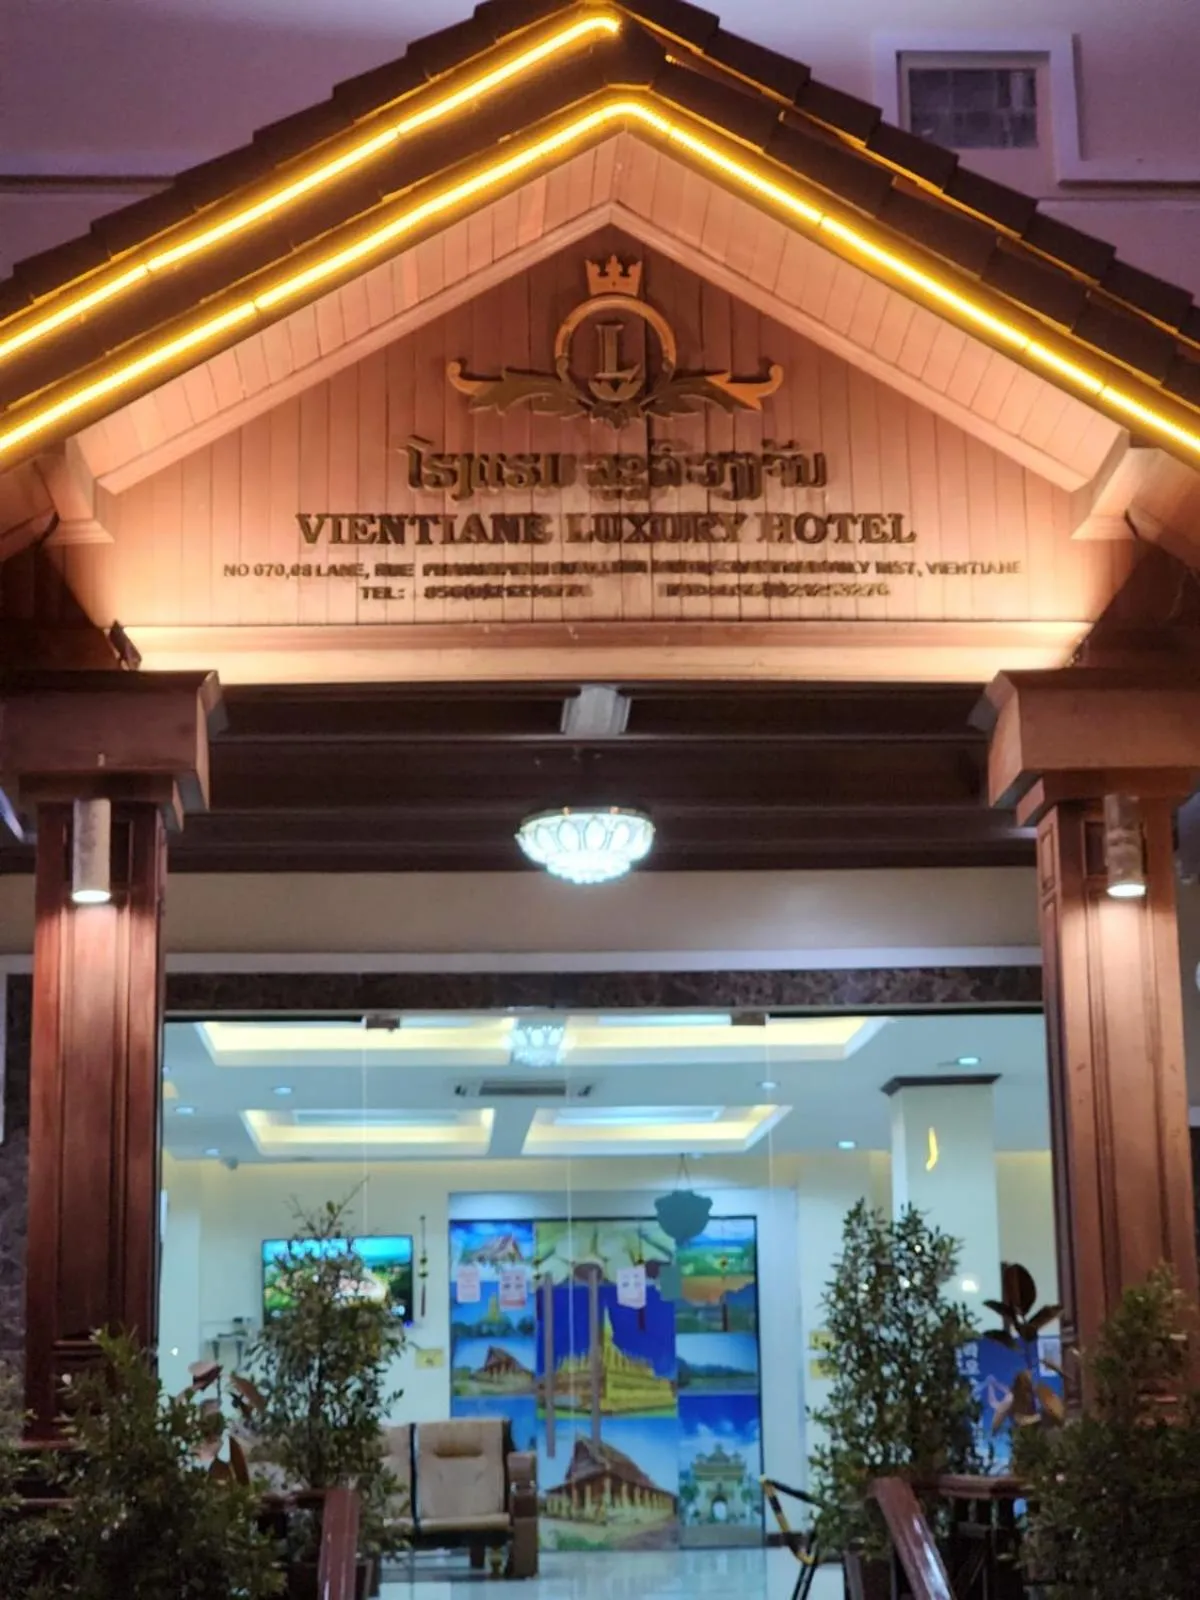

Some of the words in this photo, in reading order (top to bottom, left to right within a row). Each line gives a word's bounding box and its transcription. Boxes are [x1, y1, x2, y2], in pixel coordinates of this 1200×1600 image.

[296, 513, 552, 545] VIENTIANE
[565, 513, 748, 546] LUXURY
[756, 513, 917, 544] HOTEL
[223, 564, 250, 577] NO
[925, 561, 1021, 575] VIENTIANE
[360, 586, 405, 600] TEL:
